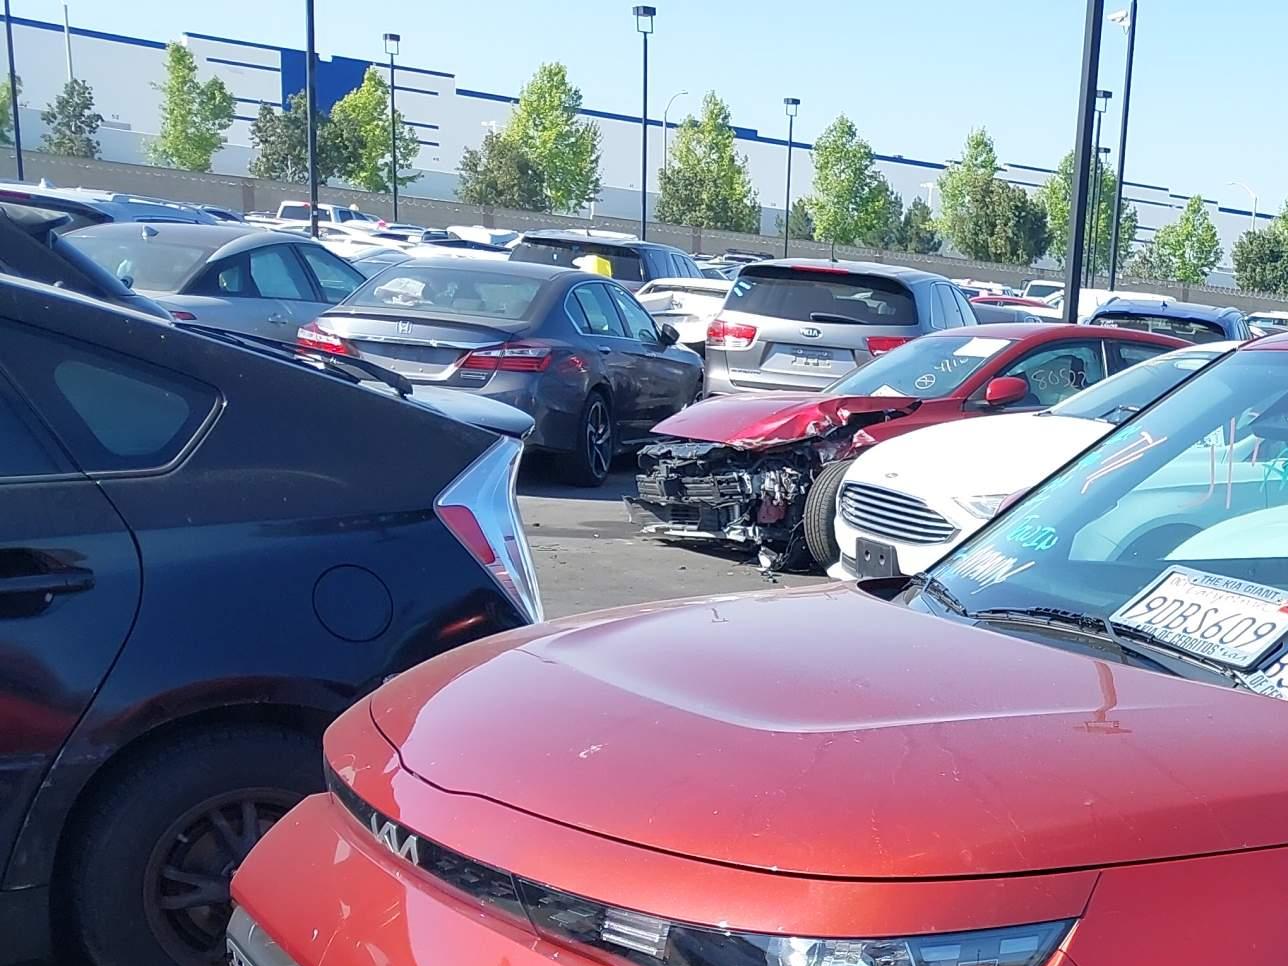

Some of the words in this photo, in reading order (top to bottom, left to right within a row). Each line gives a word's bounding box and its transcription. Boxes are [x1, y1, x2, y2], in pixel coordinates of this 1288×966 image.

[1201, 574, 1224, 587] THE
[1223, 579, 1242, 591] KIA
[1243, 585, 1281, 601] GIANT
[1128, 595, 1277, 649] 9DBS609
[1141, 623, 1156, 636] KIA
[1156, 628, 1171, 642] OF
[1169, 633, 1220, 656] CERRITOS
[1249, 674, 1268, 689] OF
[370, 812, 419, 866] KIA
